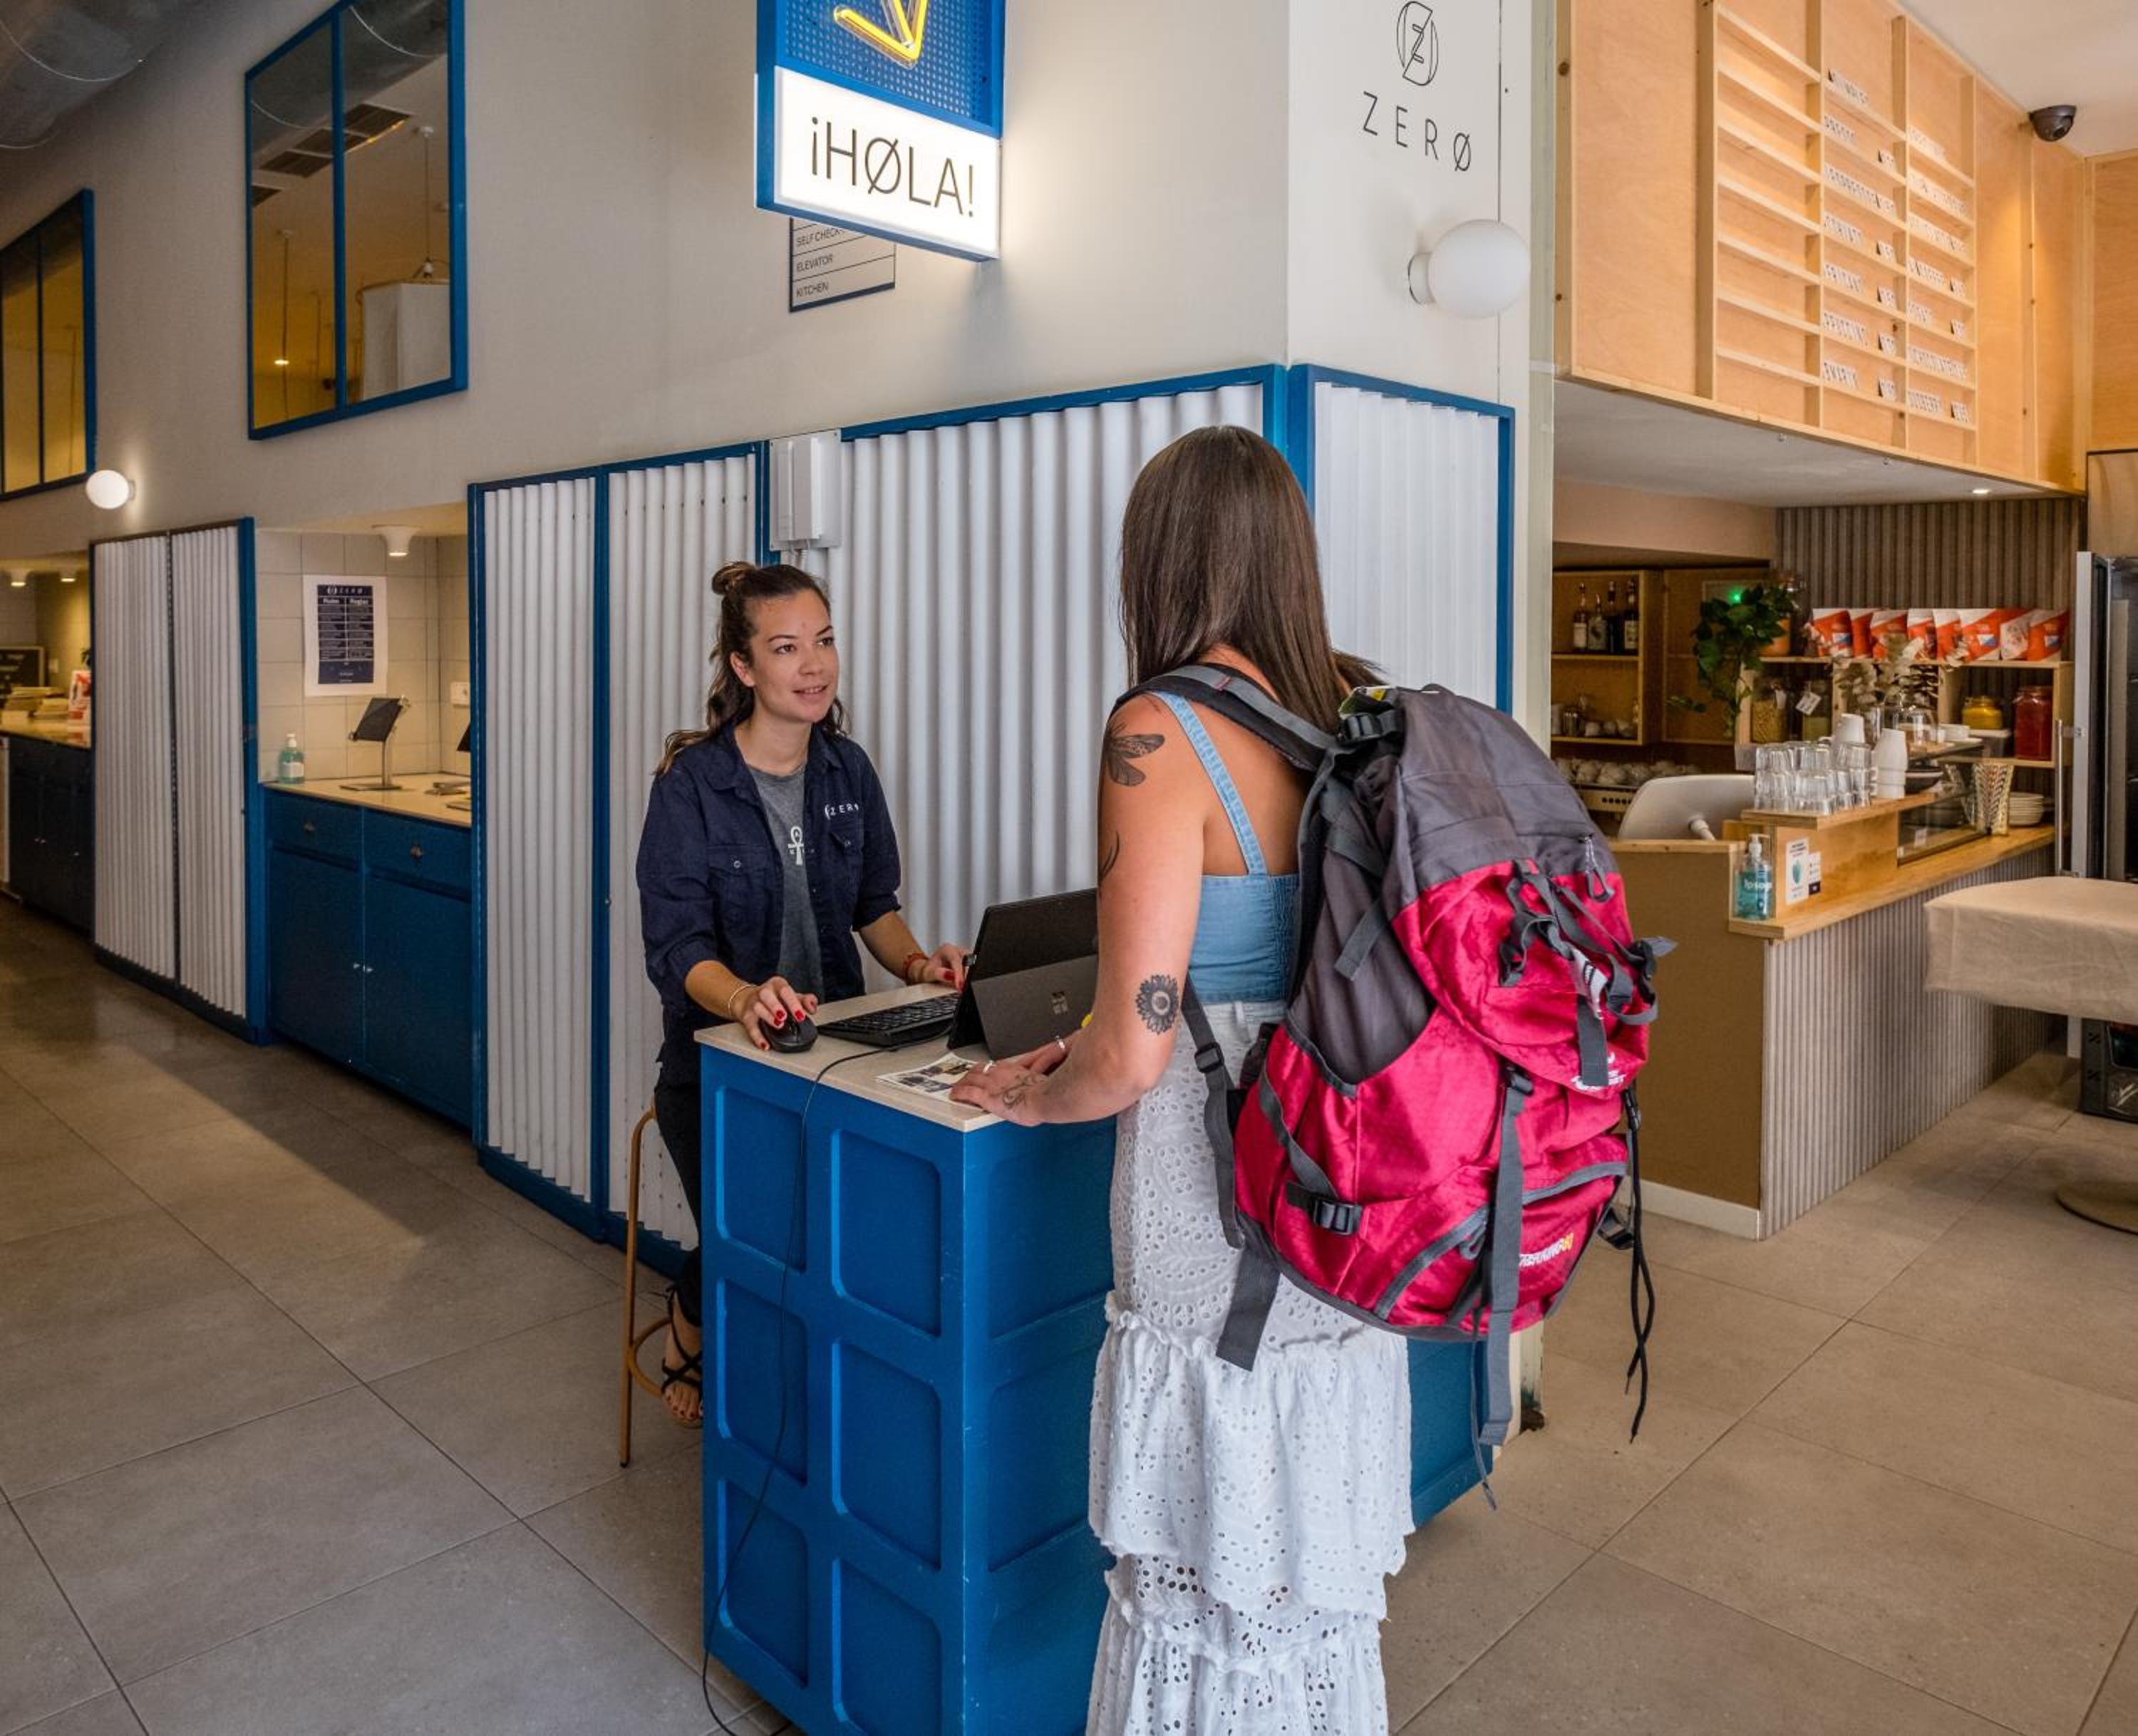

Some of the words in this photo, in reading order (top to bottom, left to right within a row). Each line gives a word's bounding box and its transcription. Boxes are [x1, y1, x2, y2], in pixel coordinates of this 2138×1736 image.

[797, 233, 814, 247] SELF
[796, 254, 833, 272] ELEVATOR
[796, 282, 829, 297] KITCHEN
